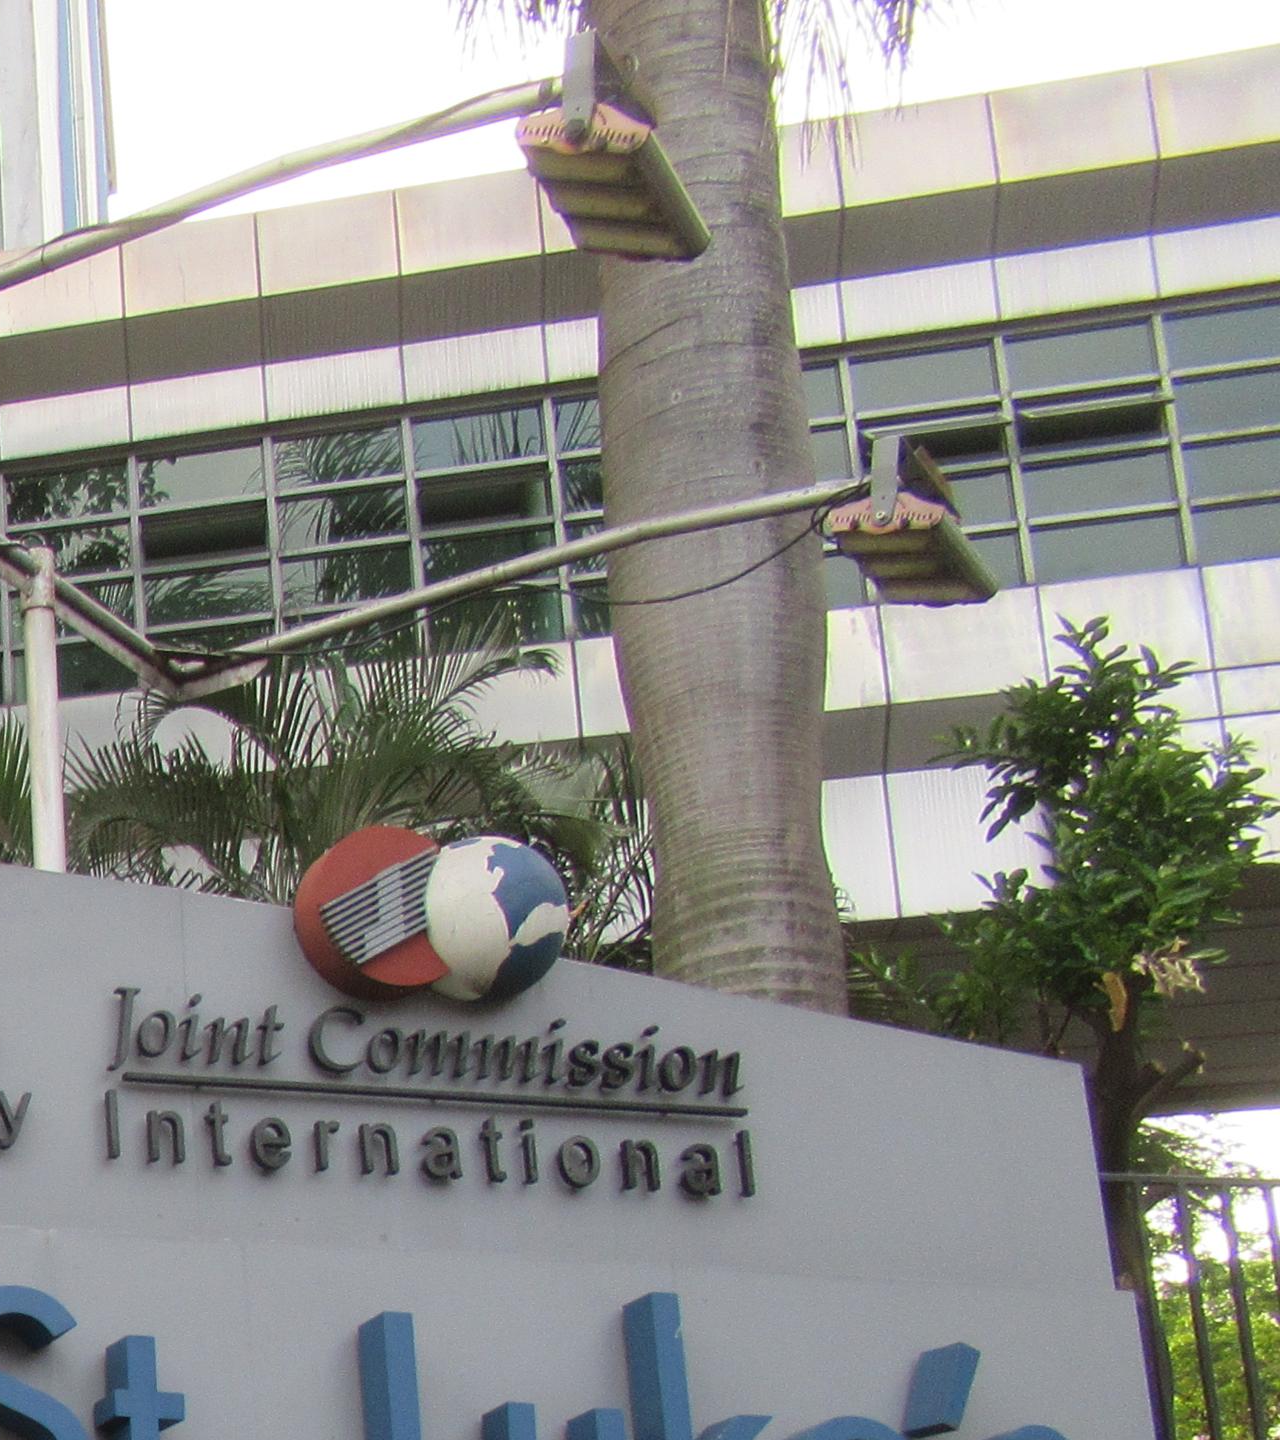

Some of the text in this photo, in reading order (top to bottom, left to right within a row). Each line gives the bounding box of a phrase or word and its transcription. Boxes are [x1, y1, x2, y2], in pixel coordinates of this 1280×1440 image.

[107, 986, 745, 1098] Joint Commission
[105, 1089, 757, 1199] International
